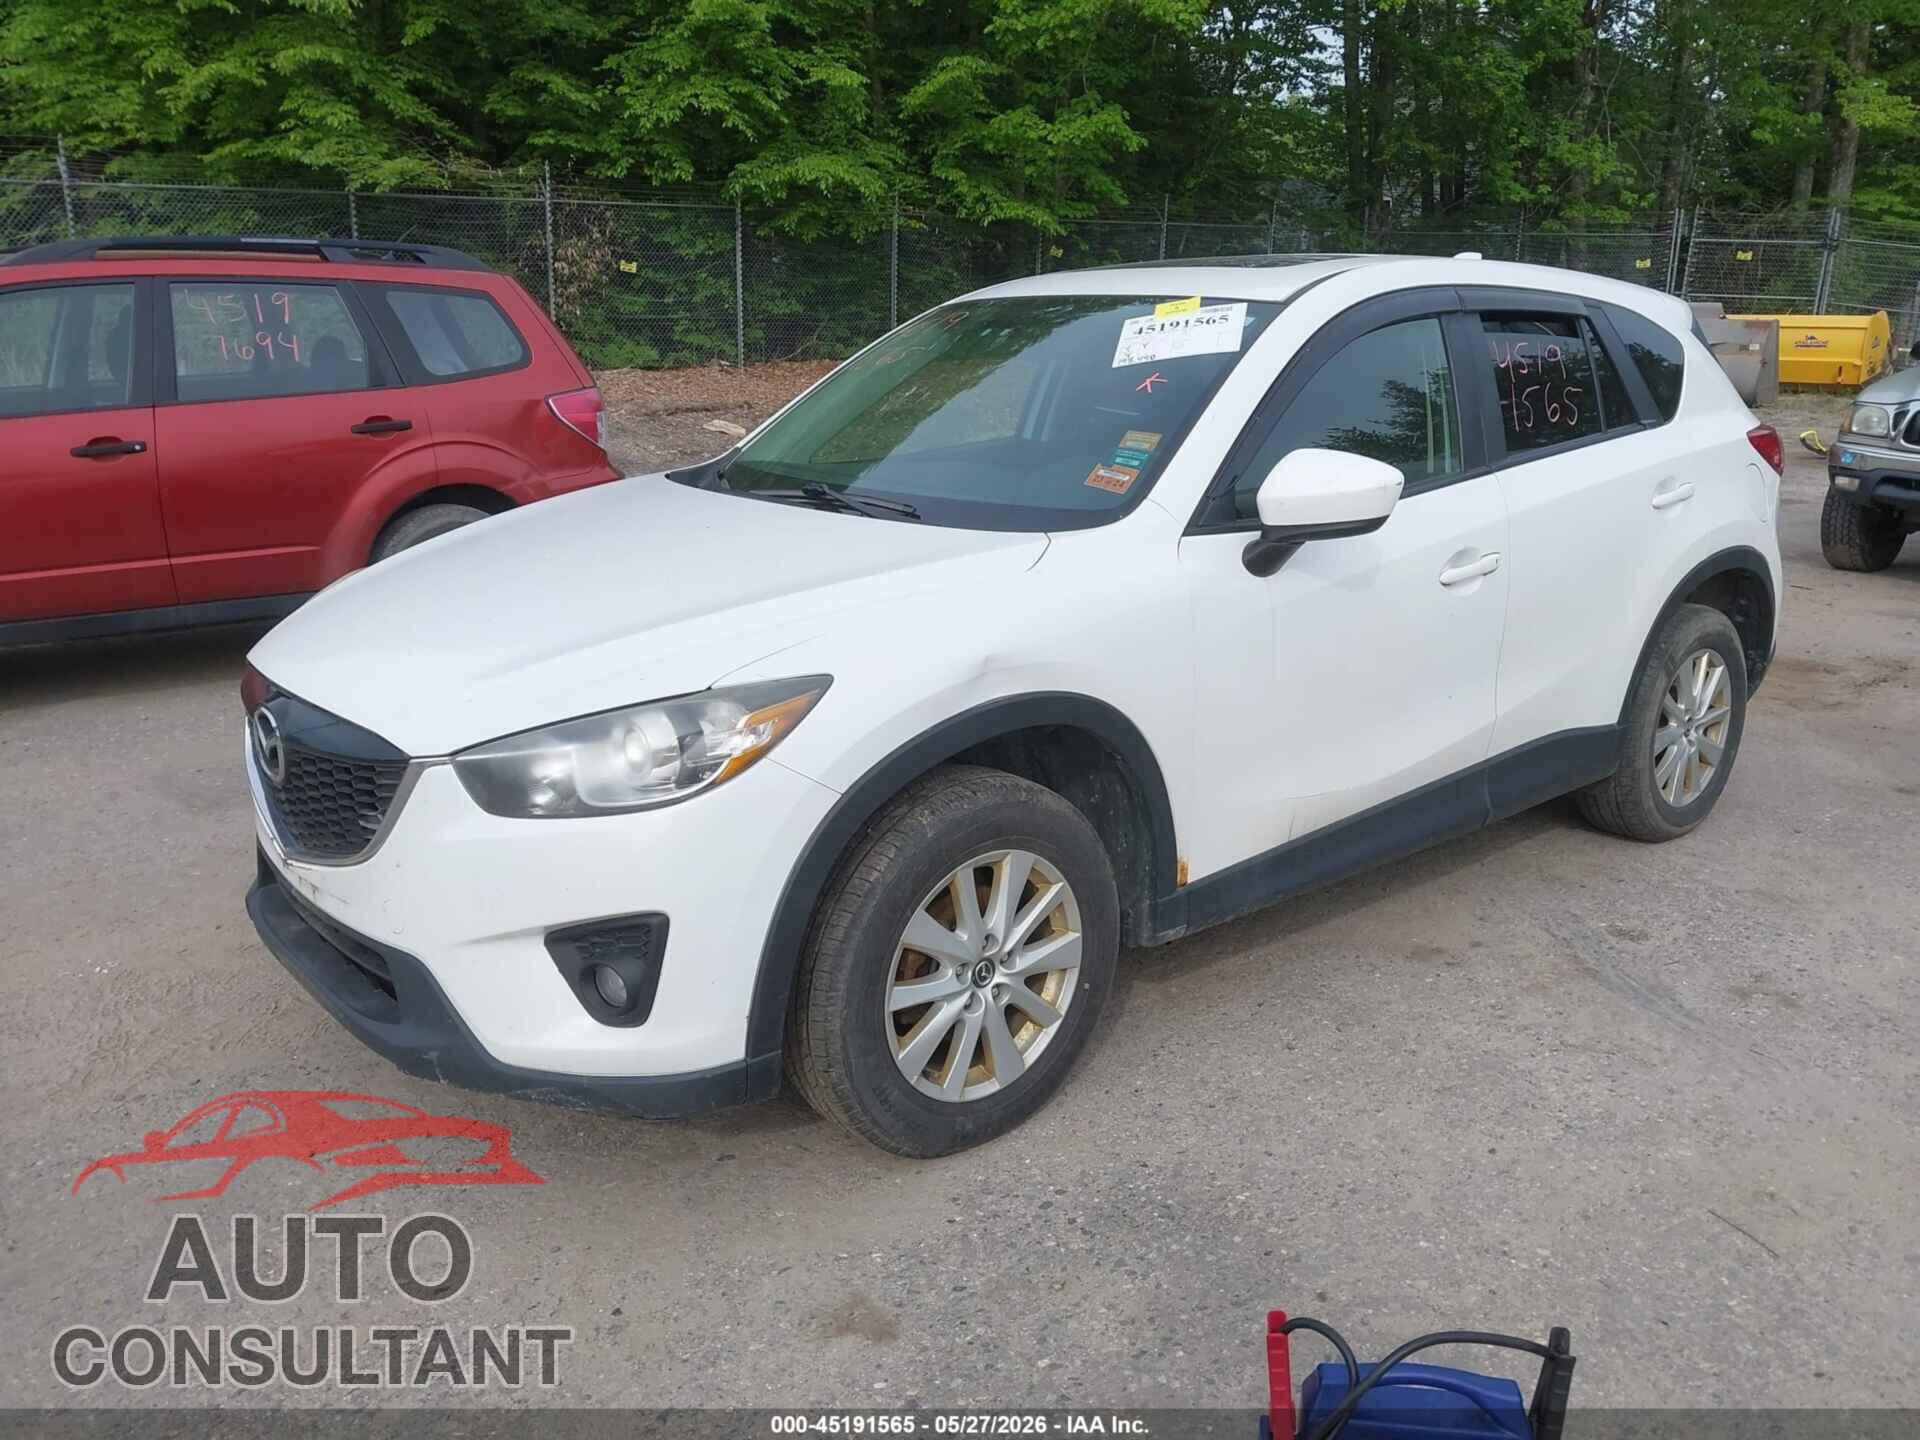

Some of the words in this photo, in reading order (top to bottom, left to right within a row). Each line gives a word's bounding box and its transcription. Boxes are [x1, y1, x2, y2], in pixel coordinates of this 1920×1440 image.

[183, 288, 289, 325] 4519
[1132, 314, 1230, 335] 45191565
[1491, 340, 1567, 383] 4519
